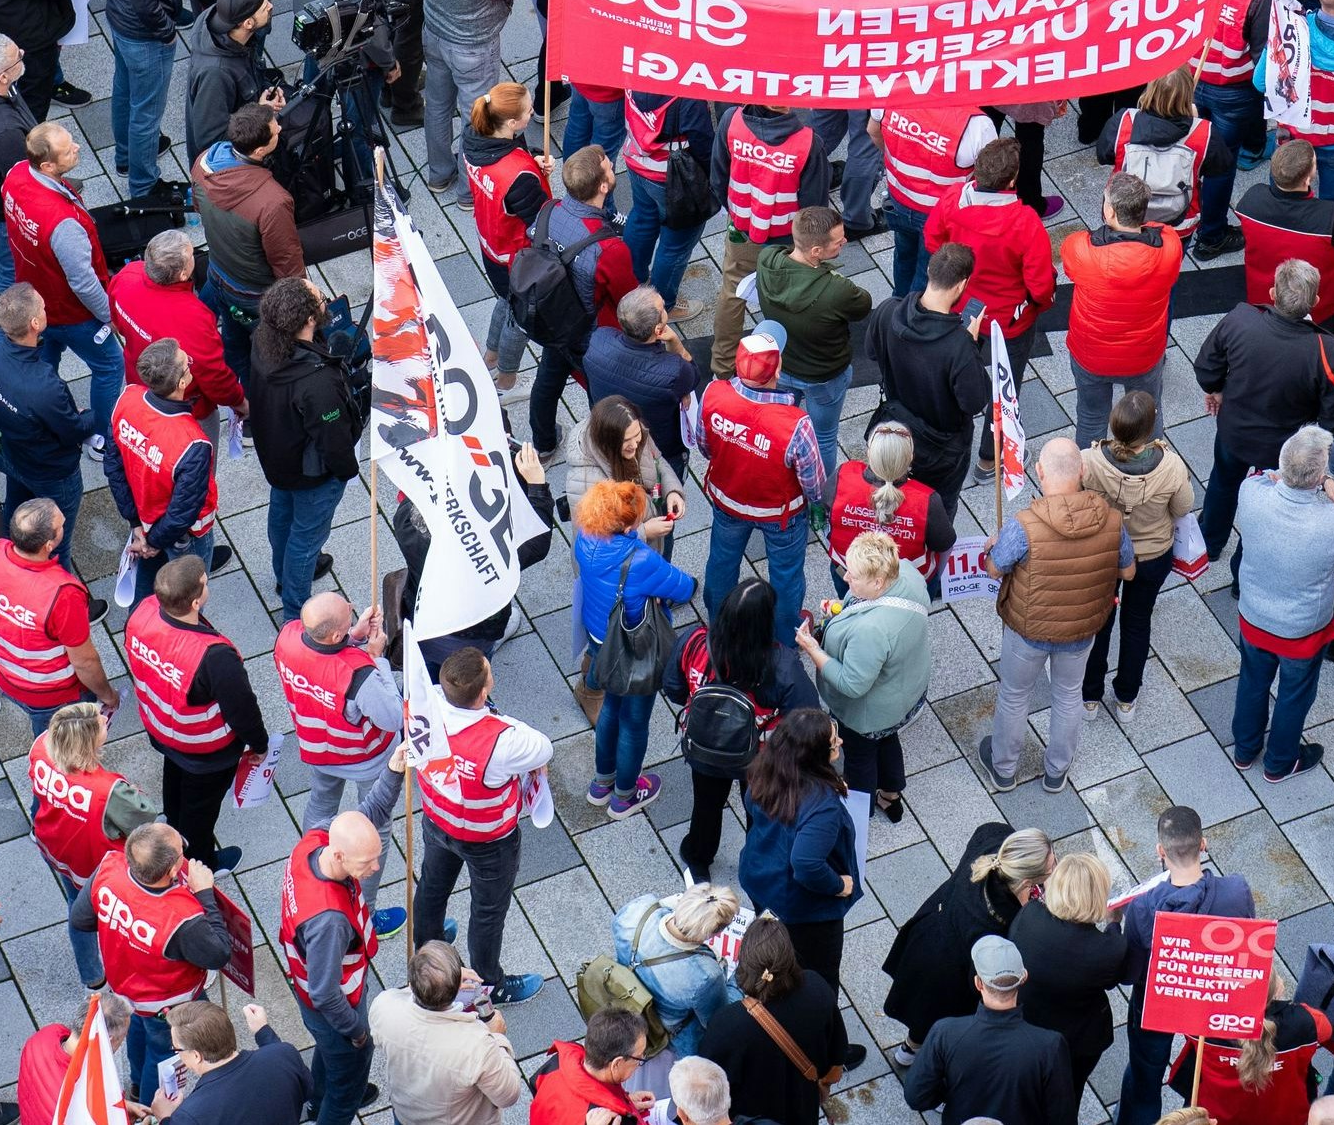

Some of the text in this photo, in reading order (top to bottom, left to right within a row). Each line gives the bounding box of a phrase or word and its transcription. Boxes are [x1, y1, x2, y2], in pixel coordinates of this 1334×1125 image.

[890, 111, 950, 151] PRO-GE
[733, 139, 799, 169] PRO-GE
[710, 412, 771, 453] GPA djp
[948, 583, 981, 594] PRO-GE
[132, 636, 184, 682] PRO-GE
[280, 661, 337, 706] PRO-GE
[34, 759, 92, 813] gpa
[98, 886, 156, 947] gpa
[1161, 936, 1191, 949] WIR
[1159, 946, 1234, 965] KÄMPFEN
[1155, 973, 1246, 990] KOLLEKTIV-
[1157, 959, 1265, 980] FÜR UNSEREN
[1154, 986, 1229, 1004] VERTRAG!
[1209, 1015, 1256, 1032] gpa
